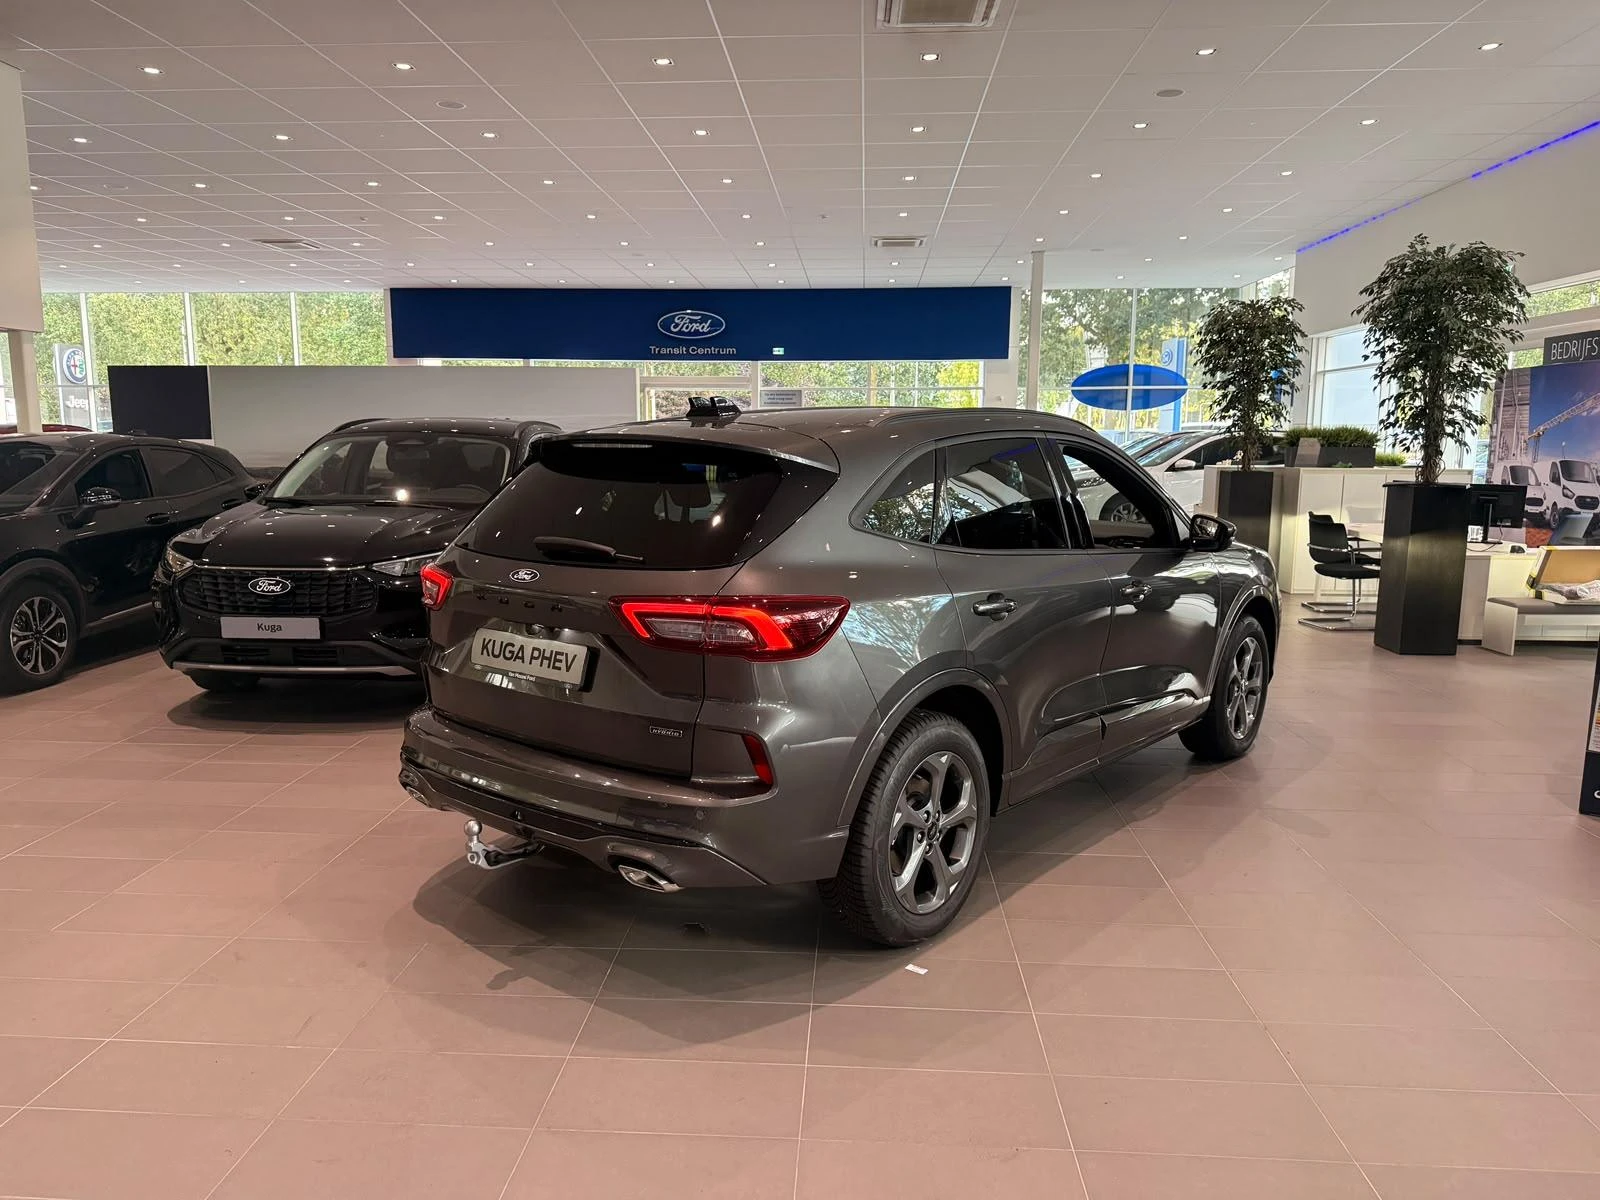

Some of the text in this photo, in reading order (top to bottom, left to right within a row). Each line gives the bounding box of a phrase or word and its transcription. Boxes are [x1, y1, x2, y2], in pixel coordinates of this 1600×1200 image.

[670, 314, 712, 333] Ford
[649, 345, 737, 355] Transit Centrum
[1550, 336, 1600, 361] BEDRIJFS
[514, 570, 535, 580] Ford
[256, 579, 282, 591] Ford
[257, 623, 282, 632] Kuga
[480, 637, 578, 673] KUGA PHEV
